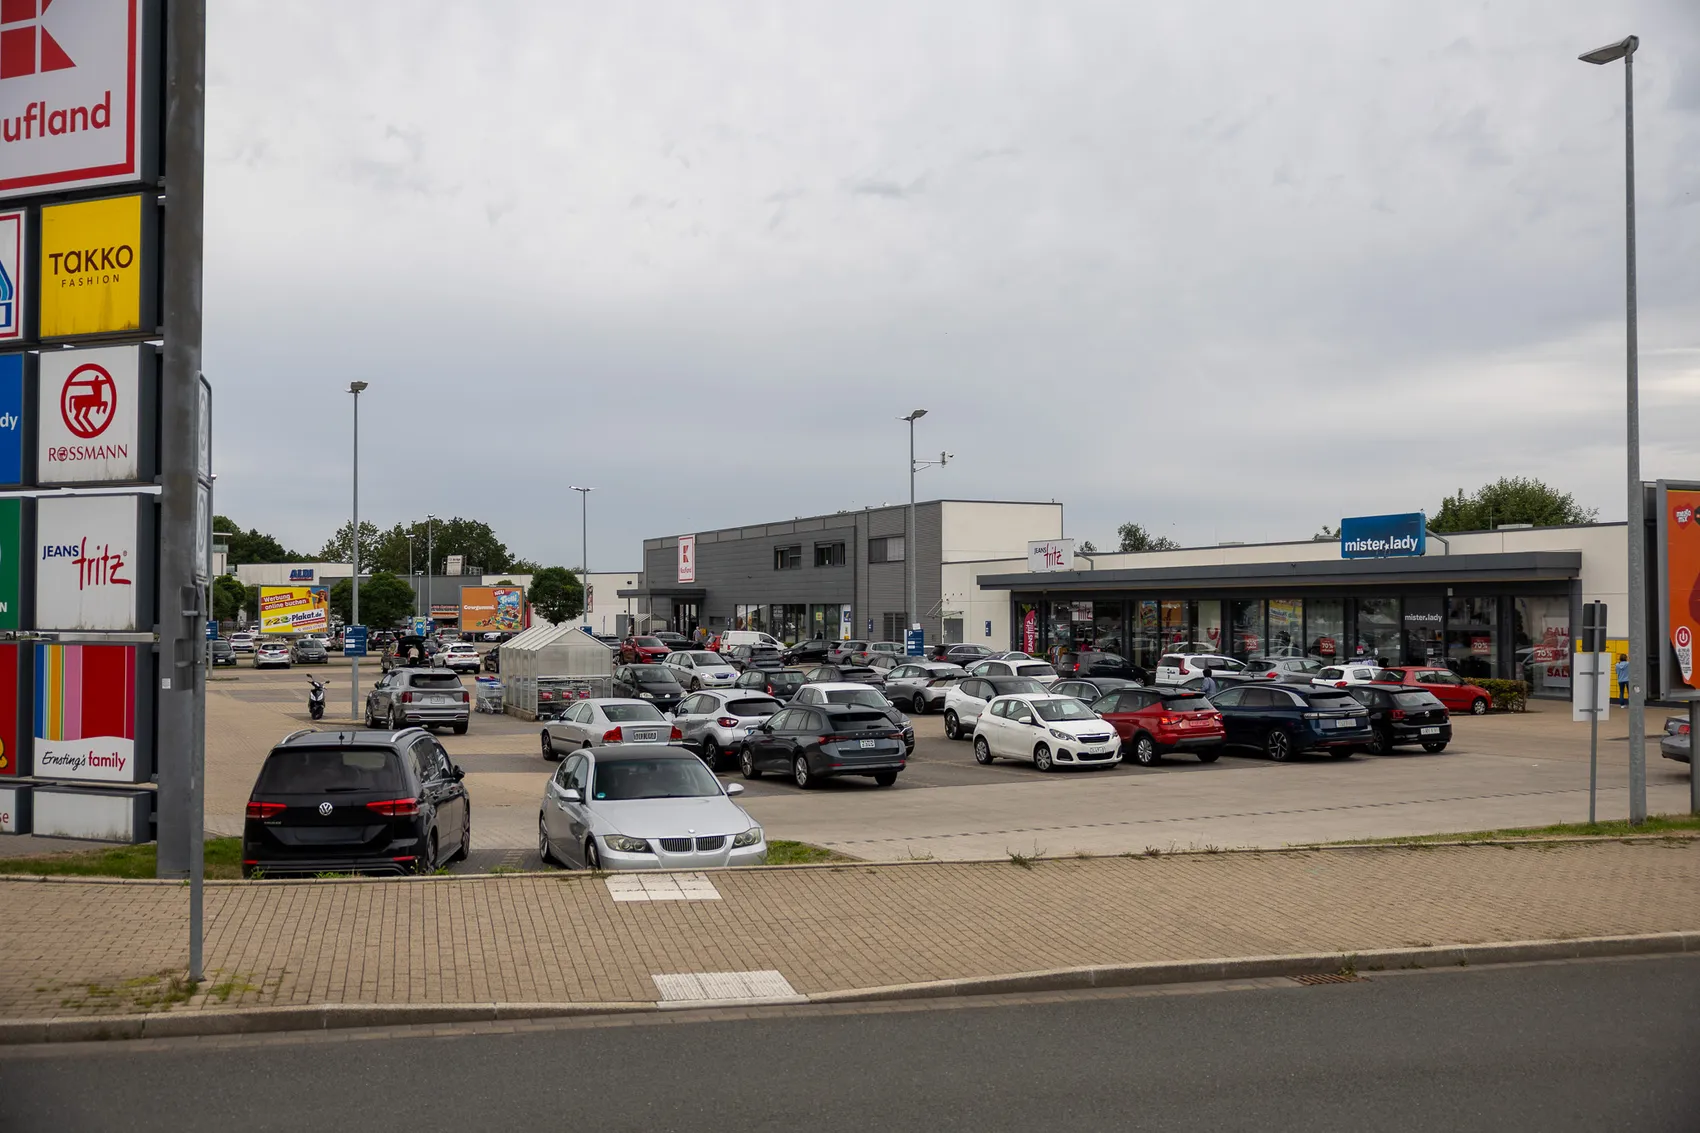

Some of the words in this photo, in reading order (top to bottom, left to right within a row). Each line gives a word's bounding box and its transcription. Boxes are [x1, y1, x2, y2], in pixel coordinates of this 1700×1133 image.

[0, 90, 111, 143] ufland
[61, 274, 121, 288] FASHION
[0, 411, 19, 431] dy
[48, 443, 129, 462] ROSSMANN
[42, 545, 80, 560] JEANS
[72, 536, 132, 591] fritz
[1034, 547, 1047, 555] JEANS
[1044, 543, 1064, 568] fritz
[289, 568, 314, 579] ALDI
[263, 593, 291, 603] Werbung
[264, 602, 284, 611] online
[284, 598, 307, 607] buchen
[1547, 627, 1570, 637] SAL
[1547, 666, 1570, 678] SAL
[42, 751, 86, 771] Ernsting's
[88, 750, 126, 772] family
